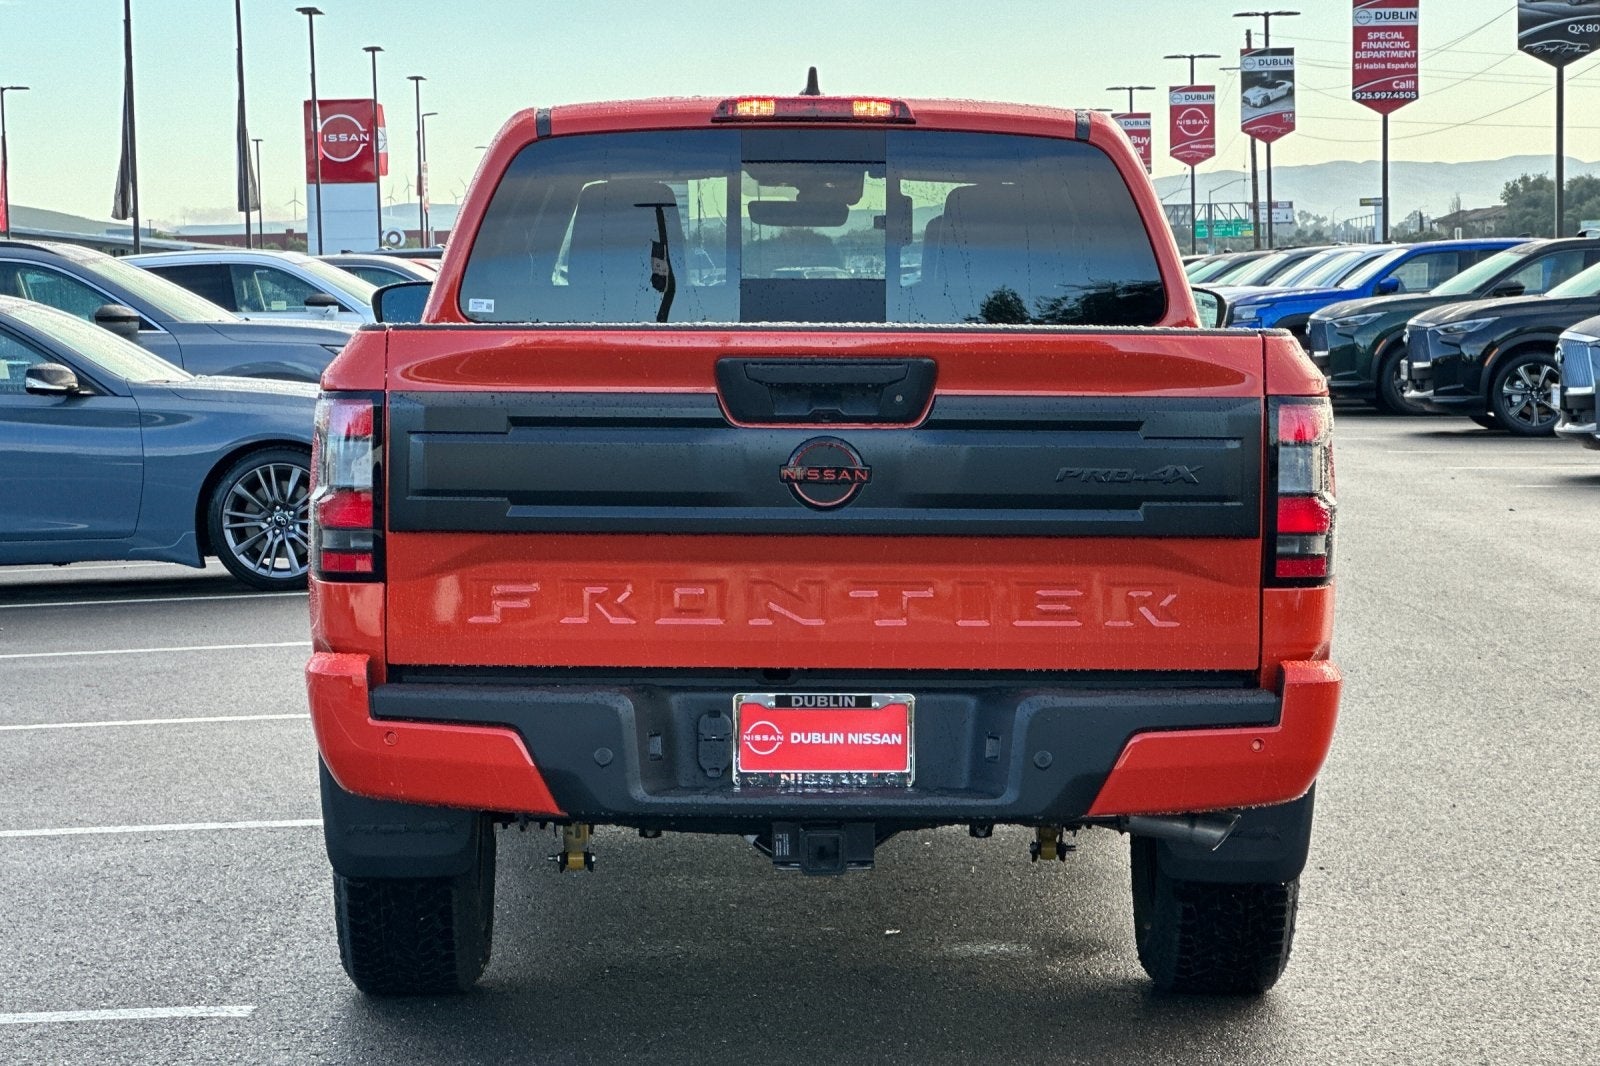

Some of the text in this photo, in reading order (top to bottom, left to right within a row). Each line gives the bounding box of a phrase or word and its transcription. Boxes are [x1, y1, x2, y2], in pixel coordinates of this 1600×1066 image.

[1374, 11, 1417, 20] DUBLIN
[1567, 23, 1600, 35] QX80
[1367, 31, 1405, 40] SPECIAL
[1361, 41, 1411, 49] FINANCING
[1355, 50, 1416, 59] DEPARTMENT
[1258, 58, 1294, 67] DUBLIN
[1386, 62, 1417, 71] Español
[1392, 80, 1415, 89] Call!
[1184, 93, 1215, 101] DUBLIN
[1354, 91, 1417, 100] 925.997.4505
[1124, 119, 1151, 127] DUBLIN
[1176, 118, 1210, 126] NISSAN
[323, 133, 370, 143] ISSAN
[1130, 135, 1150, 146] Buy
[781, 467, 869, 481] NISSAN
[1055, 464, 1204, 484] PRO-4X
[466, 578, 1182, 628] FRONTIER
[790, 694, 857, 708] DUBLIN
[743, 732, 902, 745] NISSAN DUBLIN NISSAN
